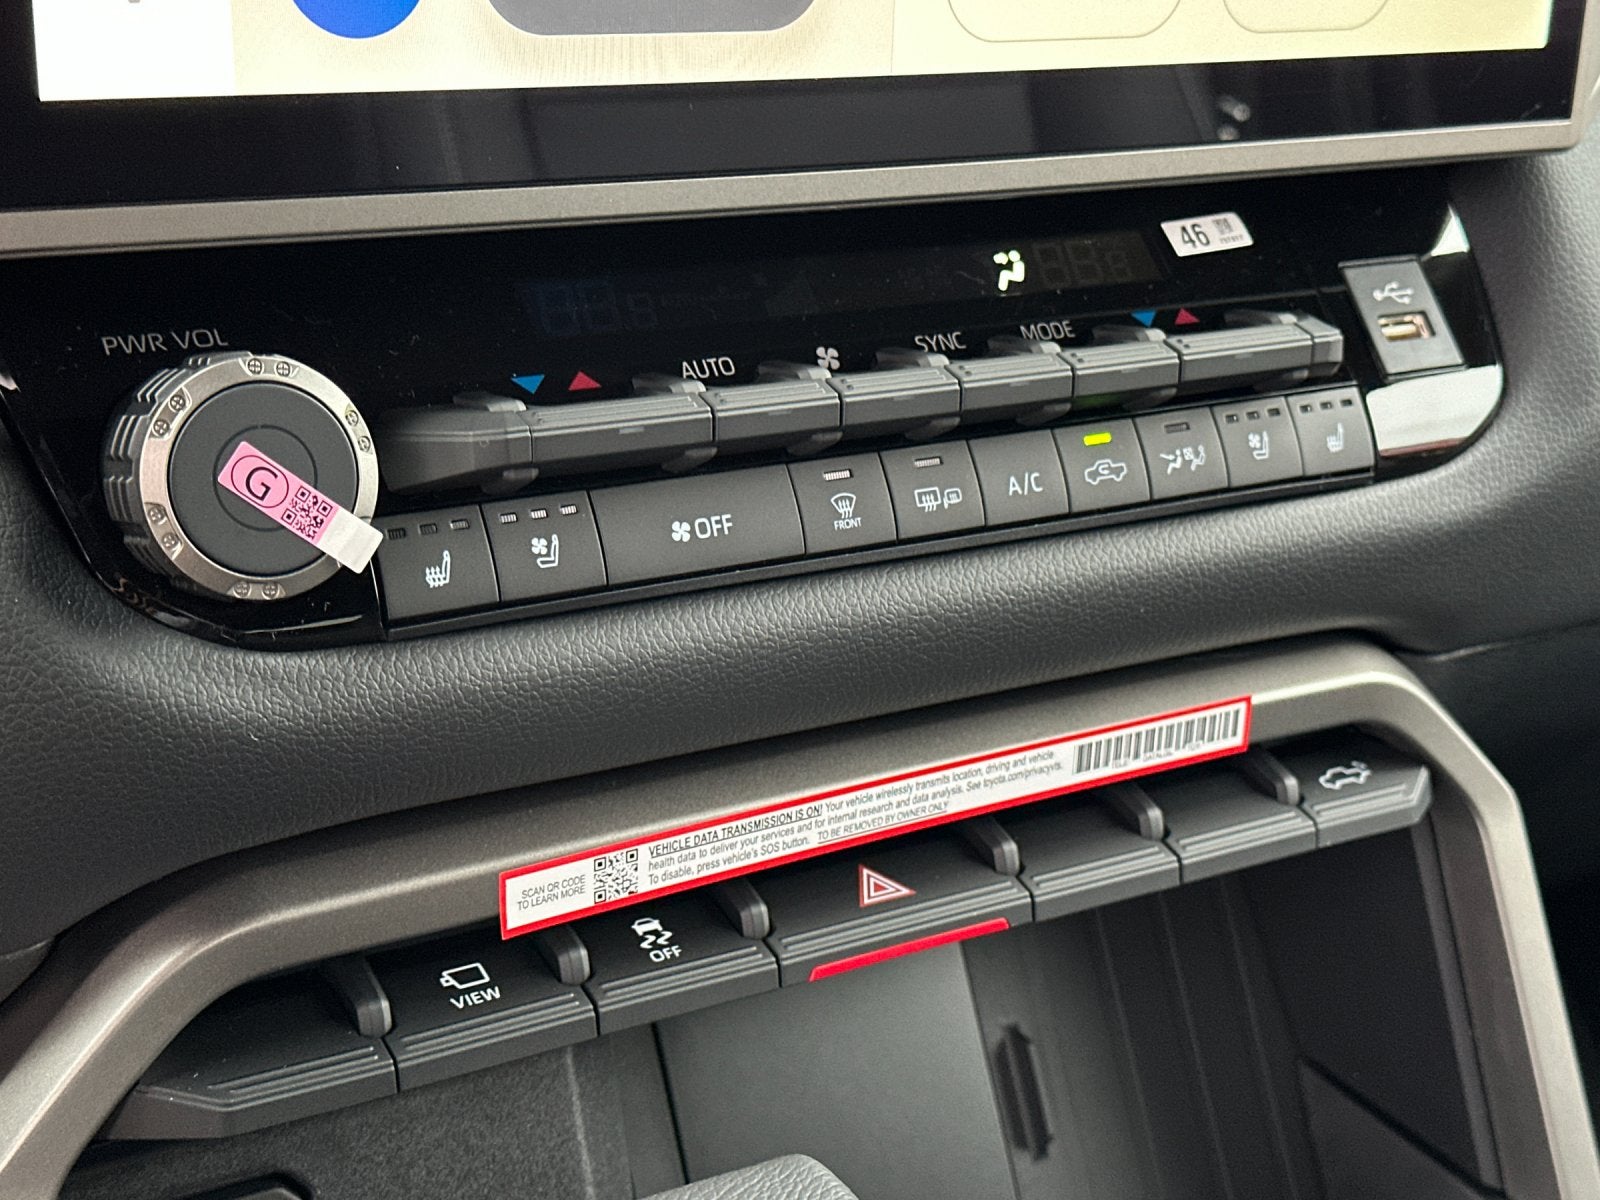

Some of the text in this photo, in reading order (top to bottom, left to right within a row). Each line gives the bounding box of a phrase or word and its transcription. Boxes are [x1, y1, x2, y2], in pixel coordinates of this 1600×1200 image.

[1180, 223, 1210, 248] 46
[101, 328, 229, 356] PWR VOL
[914, 331, 967, 353] SYNC
[1019, 320, 1076, 341] MODE
[682, 356, 736, 380] AUTO
[245, 466, 278, 502] G
[1008, 472, 1043, 496] A/C
[694, 514, 733, 539] OFF
[834, 517, 862, 531] FRONT
[648, 750, 1054, 857] VEHICLE DATA TRANSMISSION IS ON! Your vehicle wirelessly transmits location, driving and vehicle
[648, 855, 675, 872] health
[677, 851, 696, 863] data
[699, 848, 708, 858] to
[710, 841, 738, 855] deliver
[740, 835, 759, 849] your
[761, 827, 795, 842] services
[797, 821, 812, 834] and
[814, 817, 826, 828] for
[827, 809, 857, 825] internal
[859, 801, 893, 818] research
[895, 796, 910, 809] and
[912, 793, 929, 804] data
[966, 781, 981, 792] See
[648, 800, 950, 885] To disable, press vehicle's SOS button. TO BE REMOVED BY OWNER ONLY
[517, 885, 586, 911] TO LEARN MORE
[521, 885, 545, 899] SCAN
[561, 874, 586, 888] CODE
[649, 944, 682, 963] OFF
[450, 986, 501, 1009] VIEW
